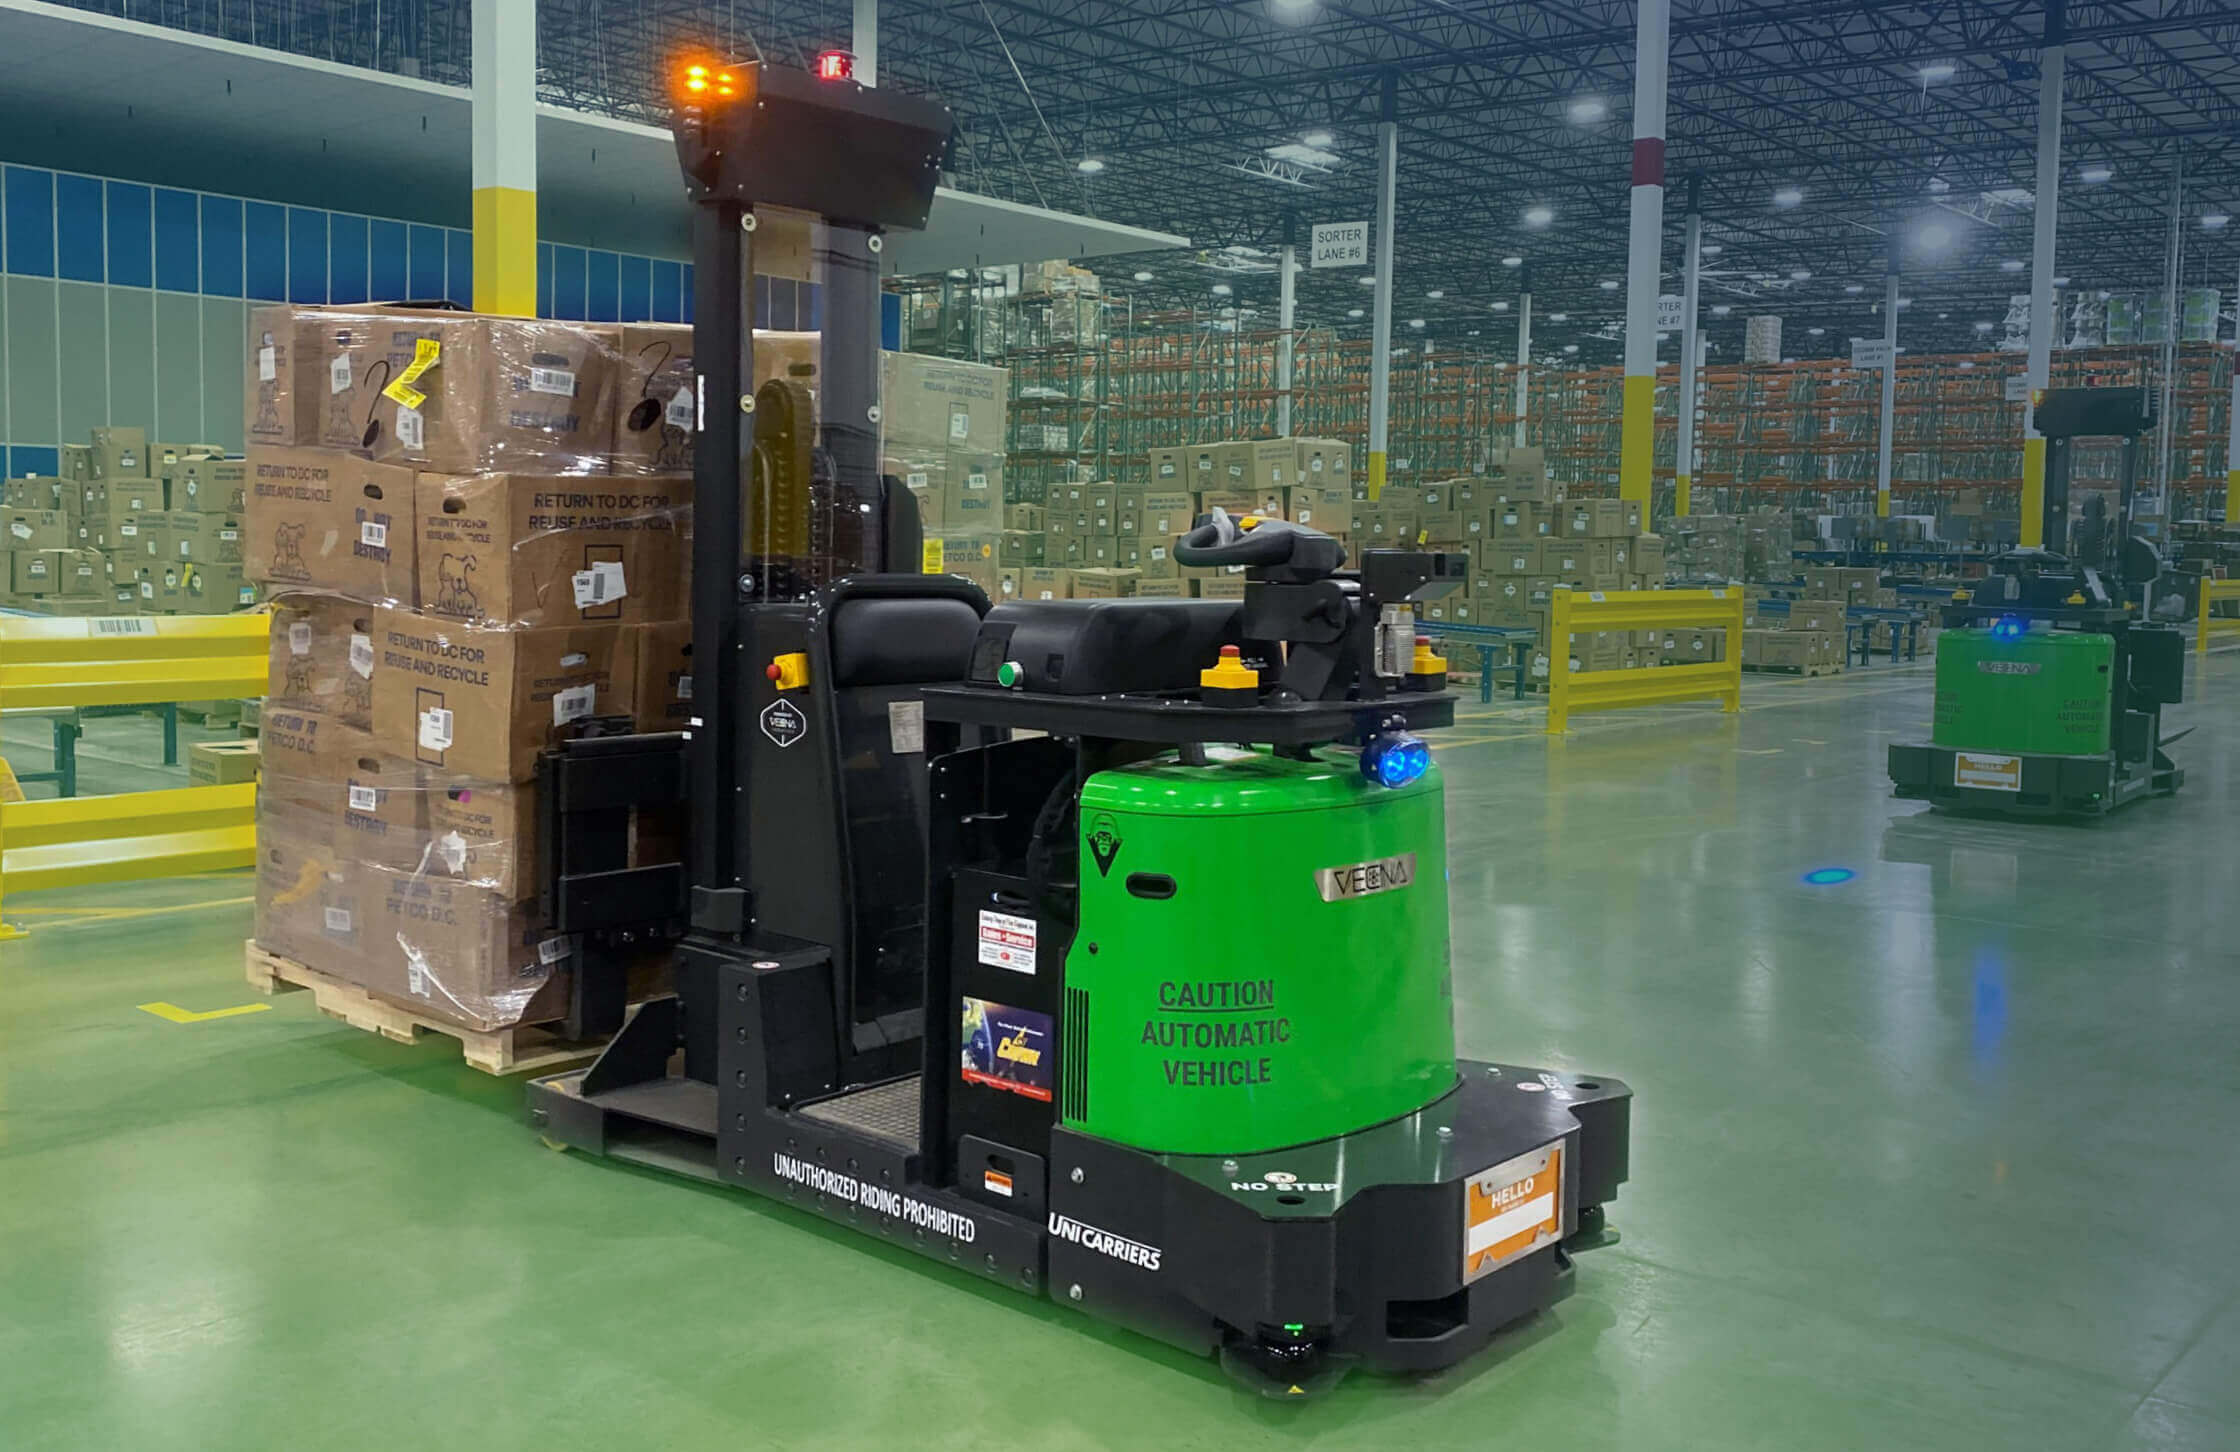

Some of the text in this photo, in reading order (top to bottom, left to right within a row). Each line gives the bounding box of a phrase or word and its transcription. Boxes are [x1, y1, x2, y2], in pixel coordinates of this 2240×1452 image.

[1318, 229, 1361, 243] SORTER
[1318, 246, 1361, 260] LANE #6
[535, 493, 670, 509] RETURN TO DC FOR
[528, 515, 576, 530] REUSE
[579, 516, 613, 530] AND
[388, 631, 424, 652] RETURN
[424, 640, 440, 655] TO
[460, 646, 485, 664] FOR
[413, 658, 436, 675] AND
[437, 663, 489, 686] RECYCLE
[1160, 980, 1273, 1007] CAUTION
[1141, 1018, 1290, 1048] AUTOMATIC
[1163, 1058, 1271, 1086] VEHICLE
[774, 1152, 976, 1243] UNAUTHORIZED RIDING PROHIBITED
[1230, 1182, 1340, 1191] NO STEP
[1492, 1177, 1534, 1208] HELLO
[1048, 1212, 1161, 1271] UNICARRIERS
